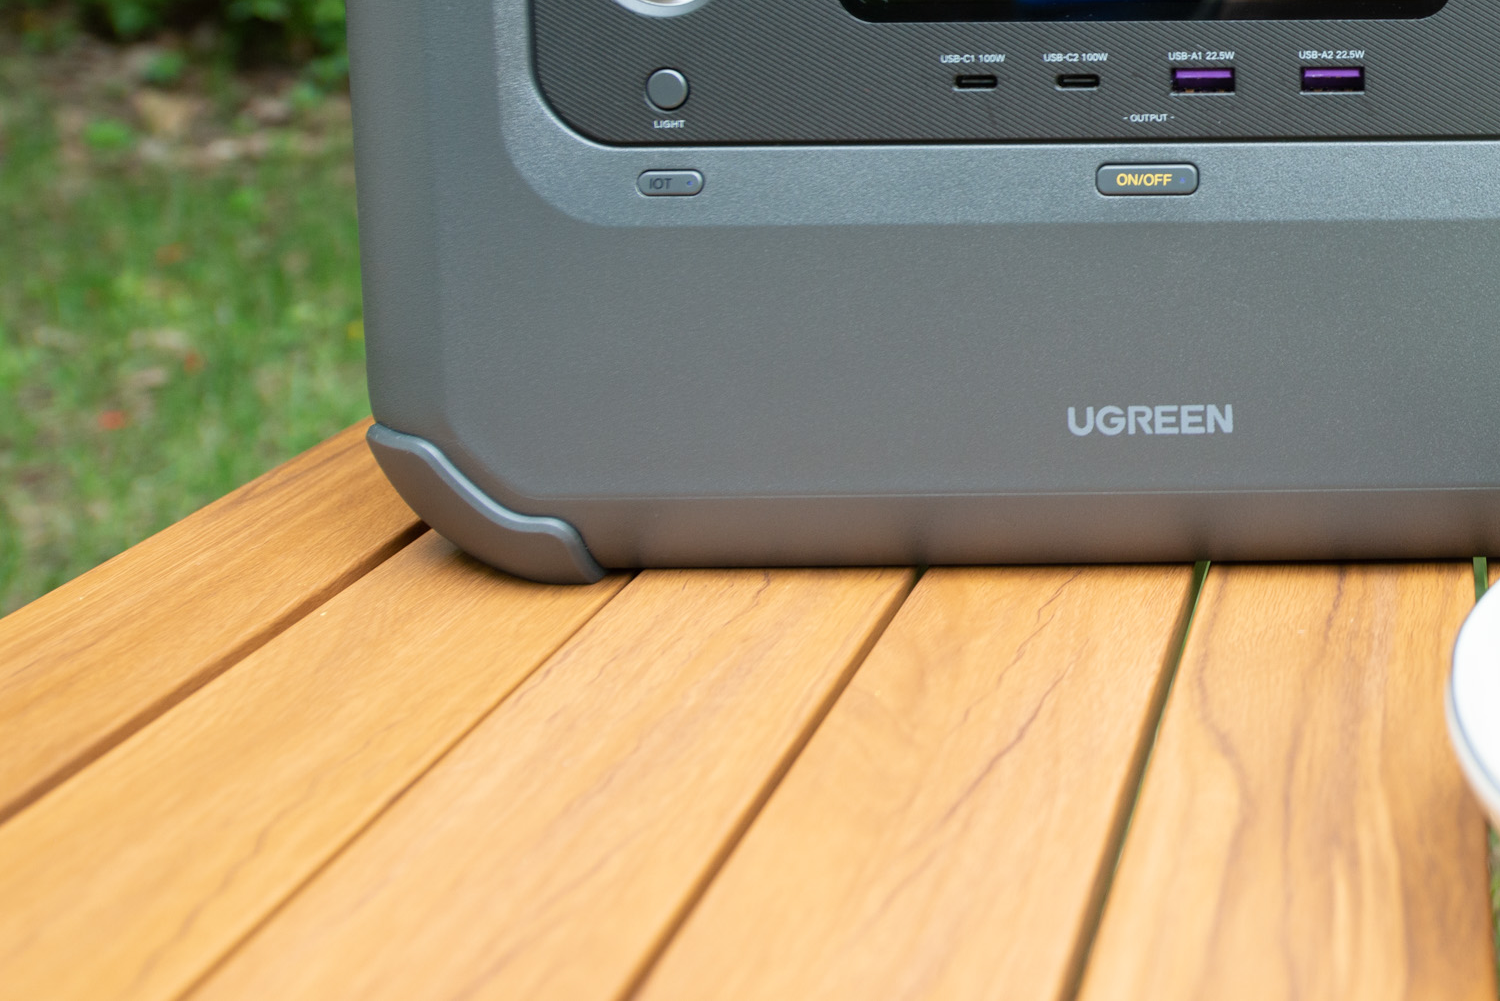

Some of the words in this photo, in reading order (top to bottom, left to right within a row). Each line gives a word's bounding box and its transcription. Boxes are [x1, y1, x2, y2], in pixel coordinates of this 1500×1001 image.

[940, 54, 975, 63] USB-C1
[978, 54, 1005, 63] 100W
[1043, 53, 1079, 62] USB-C2
[1081, 53, 1108, 62] 100W
[1168, 51, 1202, 60] USB-A1
[1205, 51, 1235, 60] 22.5W
[1298, 50, 1333, 59] USB-A2
[1336, 50, 1365, 59] 22.5W
[1130, 114, 1168, 122] OUTPUT
[653, 120, 685, 128] LIGHT
[649, 178, 672, 189] IOT
[1116, 173, 1172, 186] ON/OFF
[1067, 403, 1234, 437] UGREEN
